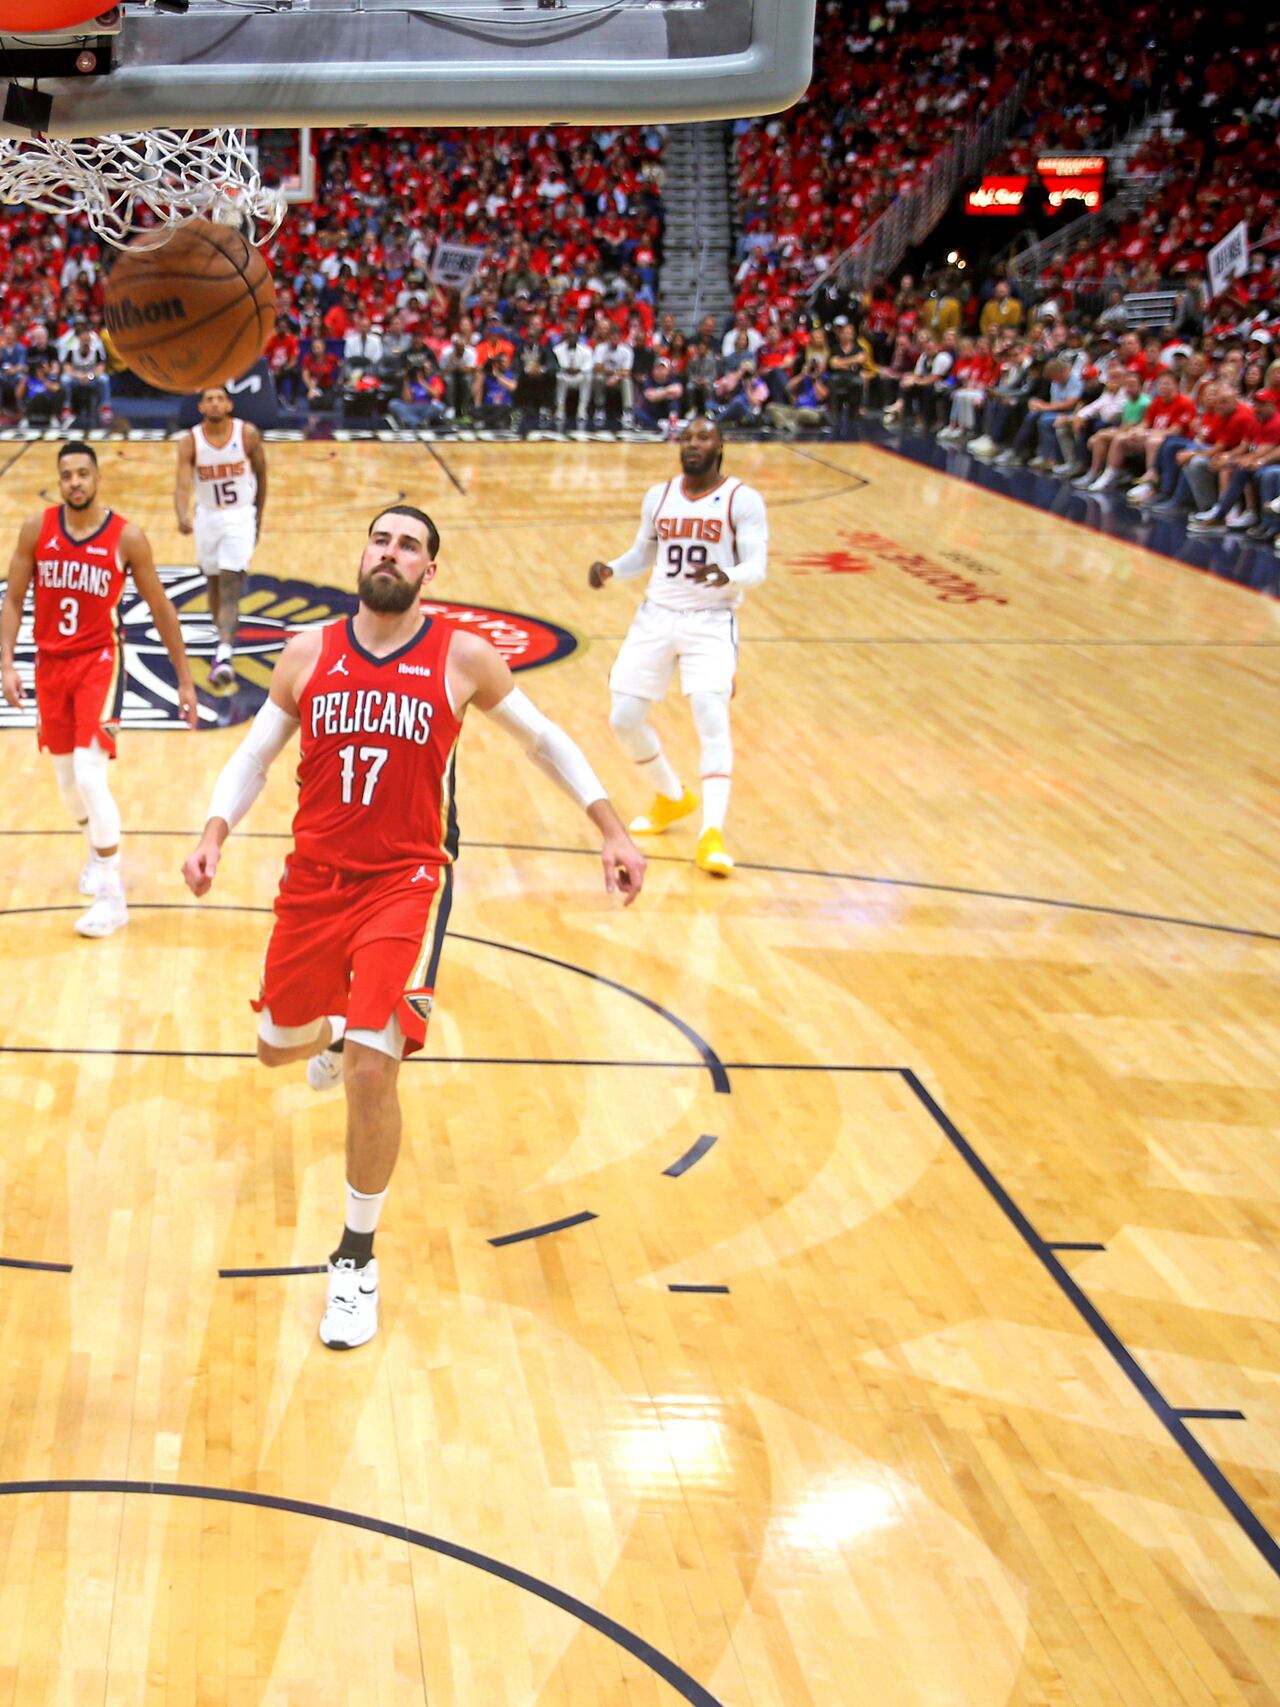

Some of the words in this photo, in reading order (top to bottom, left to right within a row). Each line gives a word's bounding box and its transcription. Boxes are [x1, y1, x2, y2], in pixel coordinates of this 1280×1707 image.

[213, 480, 238, 507] 15
[658, 518, 723, 544] SUNS
[37, 559, 112, 598] PELICANS
[666, 544, 708, 579] 99
[58, 596, 80, 636] 3
[311, 689, 434, 745] PELICANS
[338, 745, 389, 806] 17
